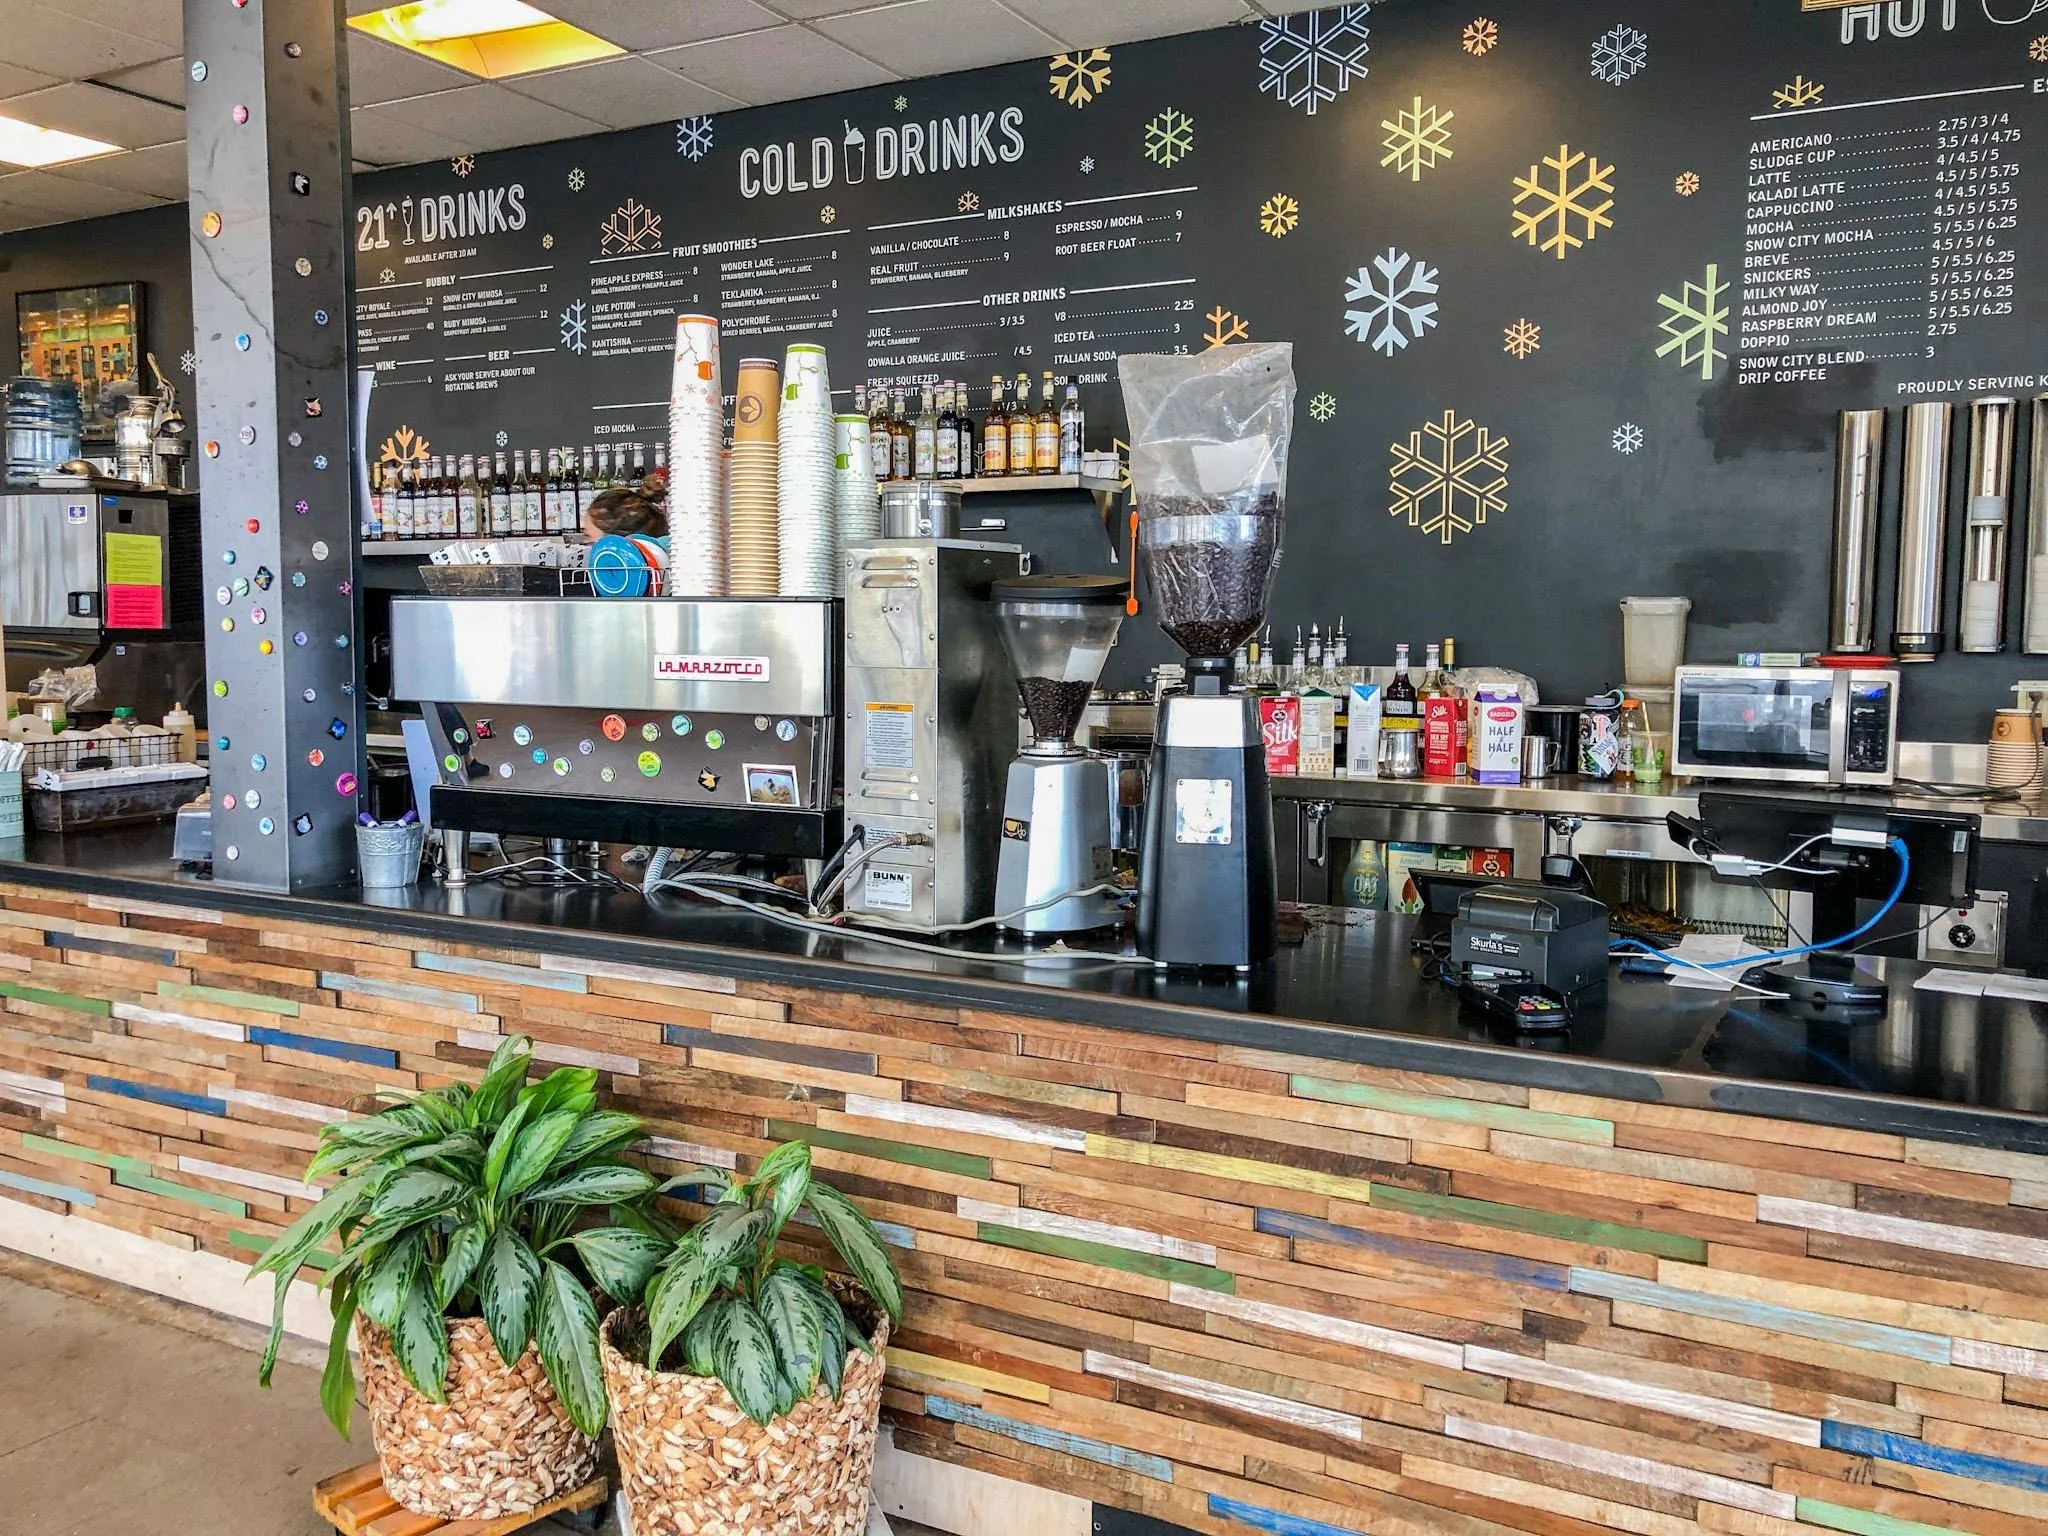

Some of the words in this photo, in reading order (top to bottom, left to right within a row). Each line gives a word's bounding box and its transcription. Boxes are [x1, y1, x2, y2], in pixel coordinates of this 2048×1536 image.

[740, 136, 834, 199] COLD
[876, 106, 1025, 180] DRINKS
[1750, 133, 1832, 154] AMERICANO
[1750, 153, 1804, 171] SLUDGE
[1807, 149, 1836, 165] CUP
[1749, 171, 1791, 186] LATTE
[1748, 187, 1798, 203] KALADI
[1802, 181, 1846, 197] LATTE
[421, 183, 527, 243] DRINKS
[987, 199, 1063, 221] MILKSHAKES
[1747, 199, 1834, 220] CAPPUCCINO
[1055, 219, 1102, 234] ESPRESSO
[1110, 215, 1143, 228] MOCHA
[1176, 209, 1183, 221] 9
[1746, 220, 1794, 236] MOCHA
[673, 245, 700, 258] FRUIT
[702, 238, 758, 254] SMOOTHIES
[870, 243, 905, 255] VANILLA
[912, 236, 960, 251] CHOCOLATE
[1004, 230, 1010, 241] 8
[1055, 243, 1078, 256] ROOT
[1080, 240, 1105, 253] BEER
[1107, 237, 1137, 250] FLOAT
[1175, 232, 1182, 243] 7
[1745, 237, 1785, 252] SNOW
[1788, 234, 1820, 249] CITY
[1824, 229, 1874, 245] MOCHA
[404, 253, 437, 265] AVAILABLE
[438, 251, 458, 262] AFTER
[459, 250, 467, 259] 10
[467, 248, 477, 257] AM
[721, 259, 753, 272] WONDER
[754, 258, 774, 269] LAKE
[831, 250, 837, 260] 8
[870, 264, 892, 275] REAL
[893, 262, 919, 273] FRUIT
[1004, 252, 1010, 262] 9
[1744, 253, 1790, 268] BREVE
[426, 275, 456, 288] BUBBLY
[591, 274, 630, 286] PINEAPPLE
[632, 270, 664, 282] EXPRESS
[693, 266, 698, 275] 8
[934, 268, 969, 280] BLUEBERRY
[1743, 268, 1812, 284] SNICKERS
[443, 293, 461, 303] SNOW
[462, 292, 476, 302] CITY
[477, 289, 503, 300] MIMOSA
[539, 284, 548, 292] 12
[721, 287, 764, 300] TEKLANIKA
[832, 280, 838, 289] 8
[983, 292, 1020, 307] OTHER
[1022, 287, 1066, 303] DRINKS
[1743, 285, 1788, 300] MILKY
[1790, 283, 1820, 297] WAY
[369, 302, 391, 312] ROYALE
[426, 297, 433, 306] 12
[592, 303, 609, 313] LOVE
[610, 301, 636, 312] POTION
[693, 294, 698, 303] 8
[1055, 312, 1066, 321] V8
[1174, 299, 1194, 311] 2.25
[1742, 301, 1799, 317] ALMOND
[1802, 299, 1828, 313] JOY
[444, 320, 460, 329] RUBY
[461, 317, 487, 327] MIMOSA
[539, 310, 548, 318] 12
[722, 315, 771, 328] POLYCHROME
[832, 309, 838, 318] 8
[1741, 316, 1823, 333] RASPBERRY
[1827, 311, 1877, 327] DREAM
[358, 329, 372, 337] PASS
[426, 322, 434, 330] 40
[867, 327, 891, 338] JUICE
[1054, 333, 1075, 343] ICED
[1077, 331, 1095, 341] TEA
[1174, 323, 1181, 333] 3
[1740, 334, 1790, 349] DOPPIO
[1927, 322, 1957, 337] 2.75
[592, 337, 632, 348] KANTISHNA
[887, 336, 920, 346] CRANBERRY
[488, 350, 510, 361] BEER
[868, 355, 905, 367] ODWALLA
[907, 353, 939, 365] ORANGE
[941, 351, 966, 362] JUICE
[1054, 352, 1090, 364] ITALIAN
[1093, 351, 1117, 361] SODA
[1174, 345, 1188, 355] 3.5
[1739, 355, 1780, 370] SNOW
[1782, 353, 1814, 368] CITY
[1817, 350, 1865, 365] BLEND
[1926, 346, 1935, 359] 3
[376, 360, 397, 371] WINE
[444, 373, 457, 382] ASK
[457, 372, 474, 381] YOUR
[475, 370, 499, 380] SERVER
[500, 367, 521, 377] ABOUT
[522, 367, 536, 376] OUR
[445, 382, 475, 392] ROTATING
[476, 380, 498, 390] BREWS
[867, 376, 893, 388] FRESH
[895, 374, 939, 386] SQUEEZED
[1078, 373, 1108, 384] DRINK
[1738, 371, 1771, 385] DRIP
[1774, 368, 1827, 383] COFFEE
[1897, 379, 1964, 394] PROUDLY
[1968, 375, 2034, 391] SERVING
[594, 425, 610, 434] ICED
[611, 423, 635, 433] MOCHA
[1263, 719, 1297, 748] Silk
[1489, 726, 1515, 736] HALF
[1488, 743, 1515, 753] HALF
[873, 871, 904, 882] BUNN
